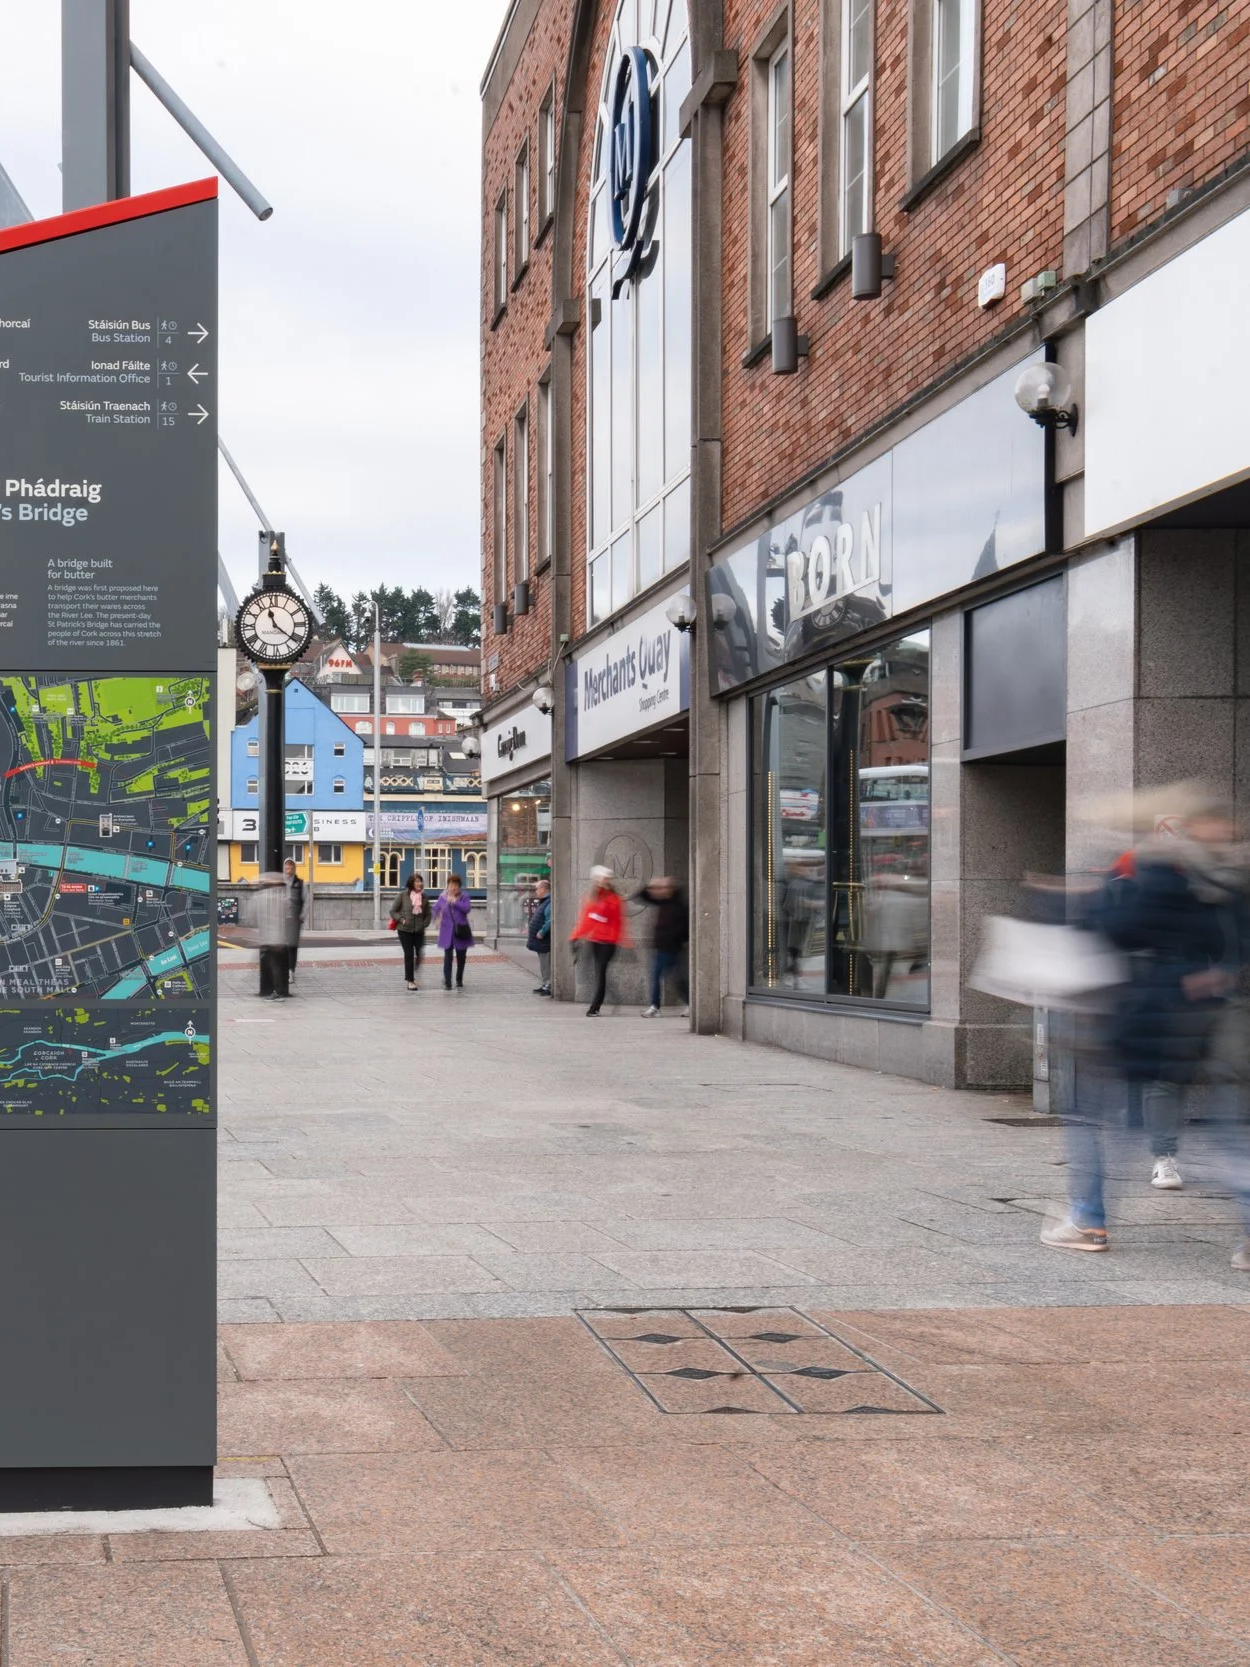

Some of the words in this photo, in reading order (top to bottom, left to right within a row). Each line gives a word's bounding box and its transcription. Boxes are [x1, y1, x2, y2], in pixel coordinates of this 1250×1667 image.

[88, 320, 128, 329] Stáisiún
[132, 321, 150, 330] Bus
[92, 333, 110, 342] Bus
[113, 333, 150, 342] Station
[165, 336, 172, 344] 4
[92, 361, 119, 370] Ionad
[122, 361, 150, 370] Fáilte
[18, 372, 54, 382] Tourist
[57, 373, 116, 383] Information
[119, 374, 150, 383] Office
[166, 377, 171, 385] 1
[60, 401, 100, 410] Stáisiún
[103, 401, 150, 411] Traenach
[86, 414, 110, 423] Train
[113, 414, 150, 423] Station
[163, 417, 174, 426] 15
[6, 477, 102, 504] Phádraig
[18, 503, 88, 526] Bridge
[48, 559, 55, 568] A
[58, 559, 88, 570] bridge
[91, 559, 113, 568] built
[787, 502, 881, 621] BORN
[48, 570, 62, 579] for
[64, 570, 95, 579] butter
[109, 585, 141, 593] proposed
[87, 621, 108, 629] Bridge
[328, 659, 352, 668] 96FM
[584, 644, 636, 711] Merchants
[639, 630, 671, 690] Quay
[639, 696, 656, 712] Shopping
[657, 688, 669, 707] Centre
